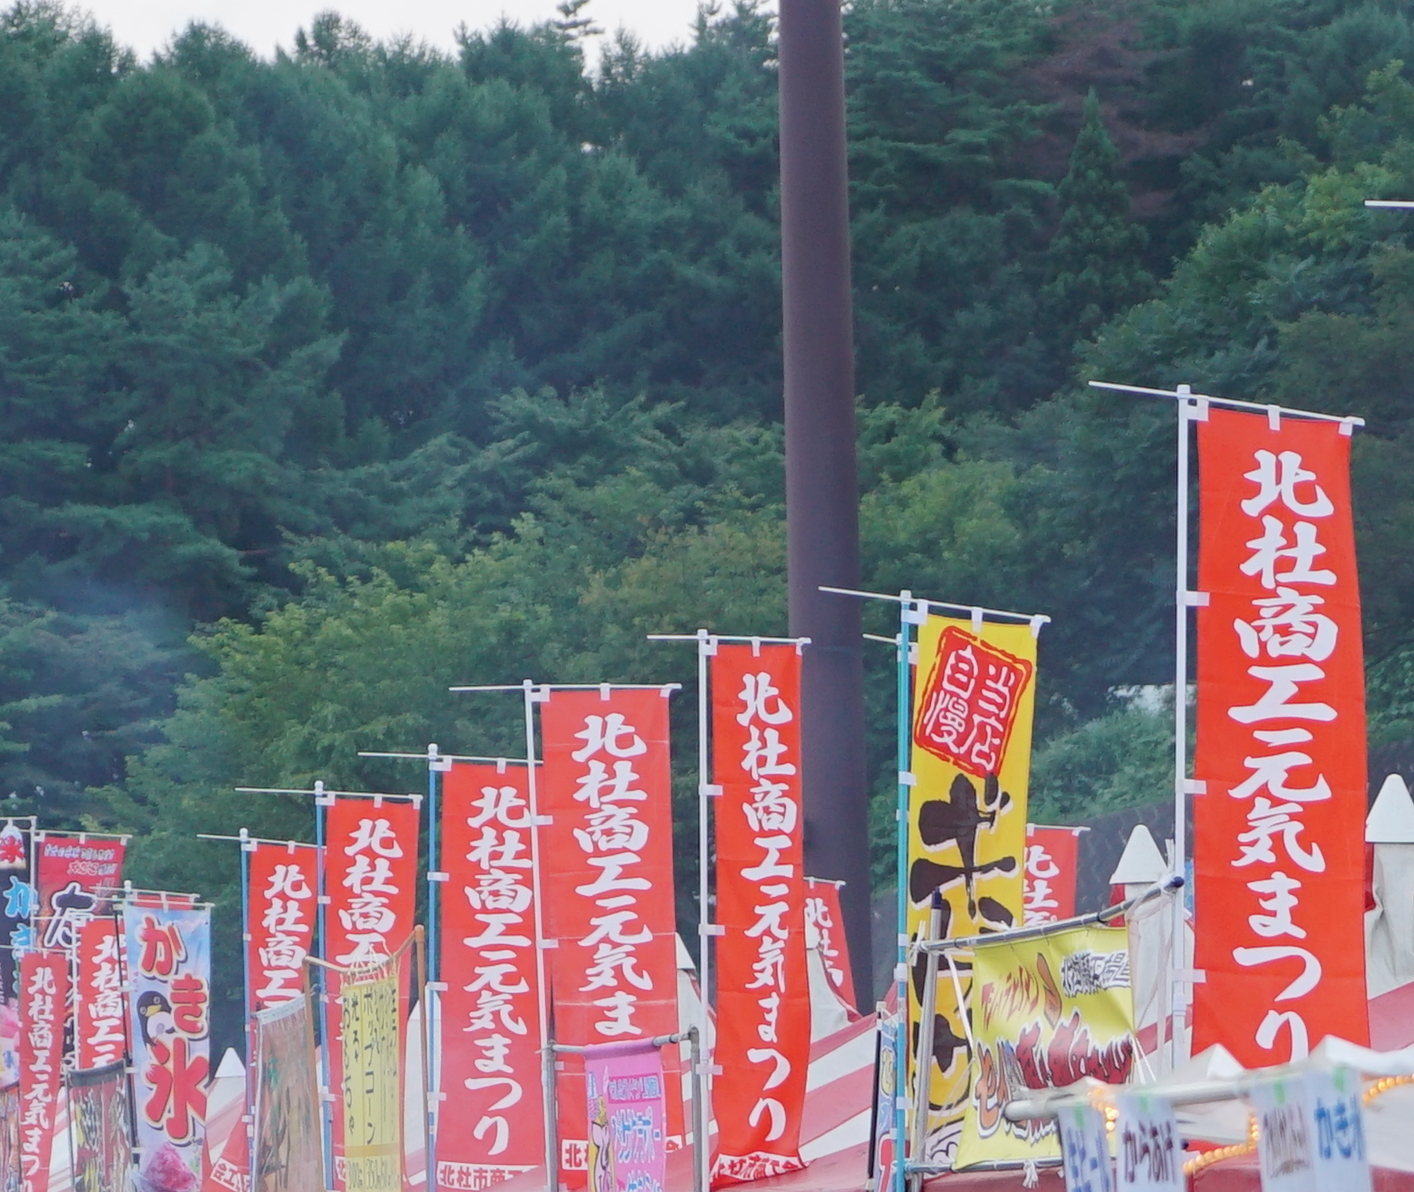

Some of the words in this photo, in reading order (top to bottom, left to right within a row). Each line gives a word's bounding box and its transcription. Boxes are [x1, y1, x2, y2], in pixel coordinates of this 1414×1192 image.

[571, 713, 654, 1036] 北杜商工元気ま
[971, 664, 1015, 771] 当店
[1227, 449, 1339, 1063] 北杜商工元気まつり
[139, 915, 211, 1144] かき氷
[463, 786, 535, 1155] 北杜商工元気まつり
[736, 671, 798, 1142] 北杜商工元気まつり
